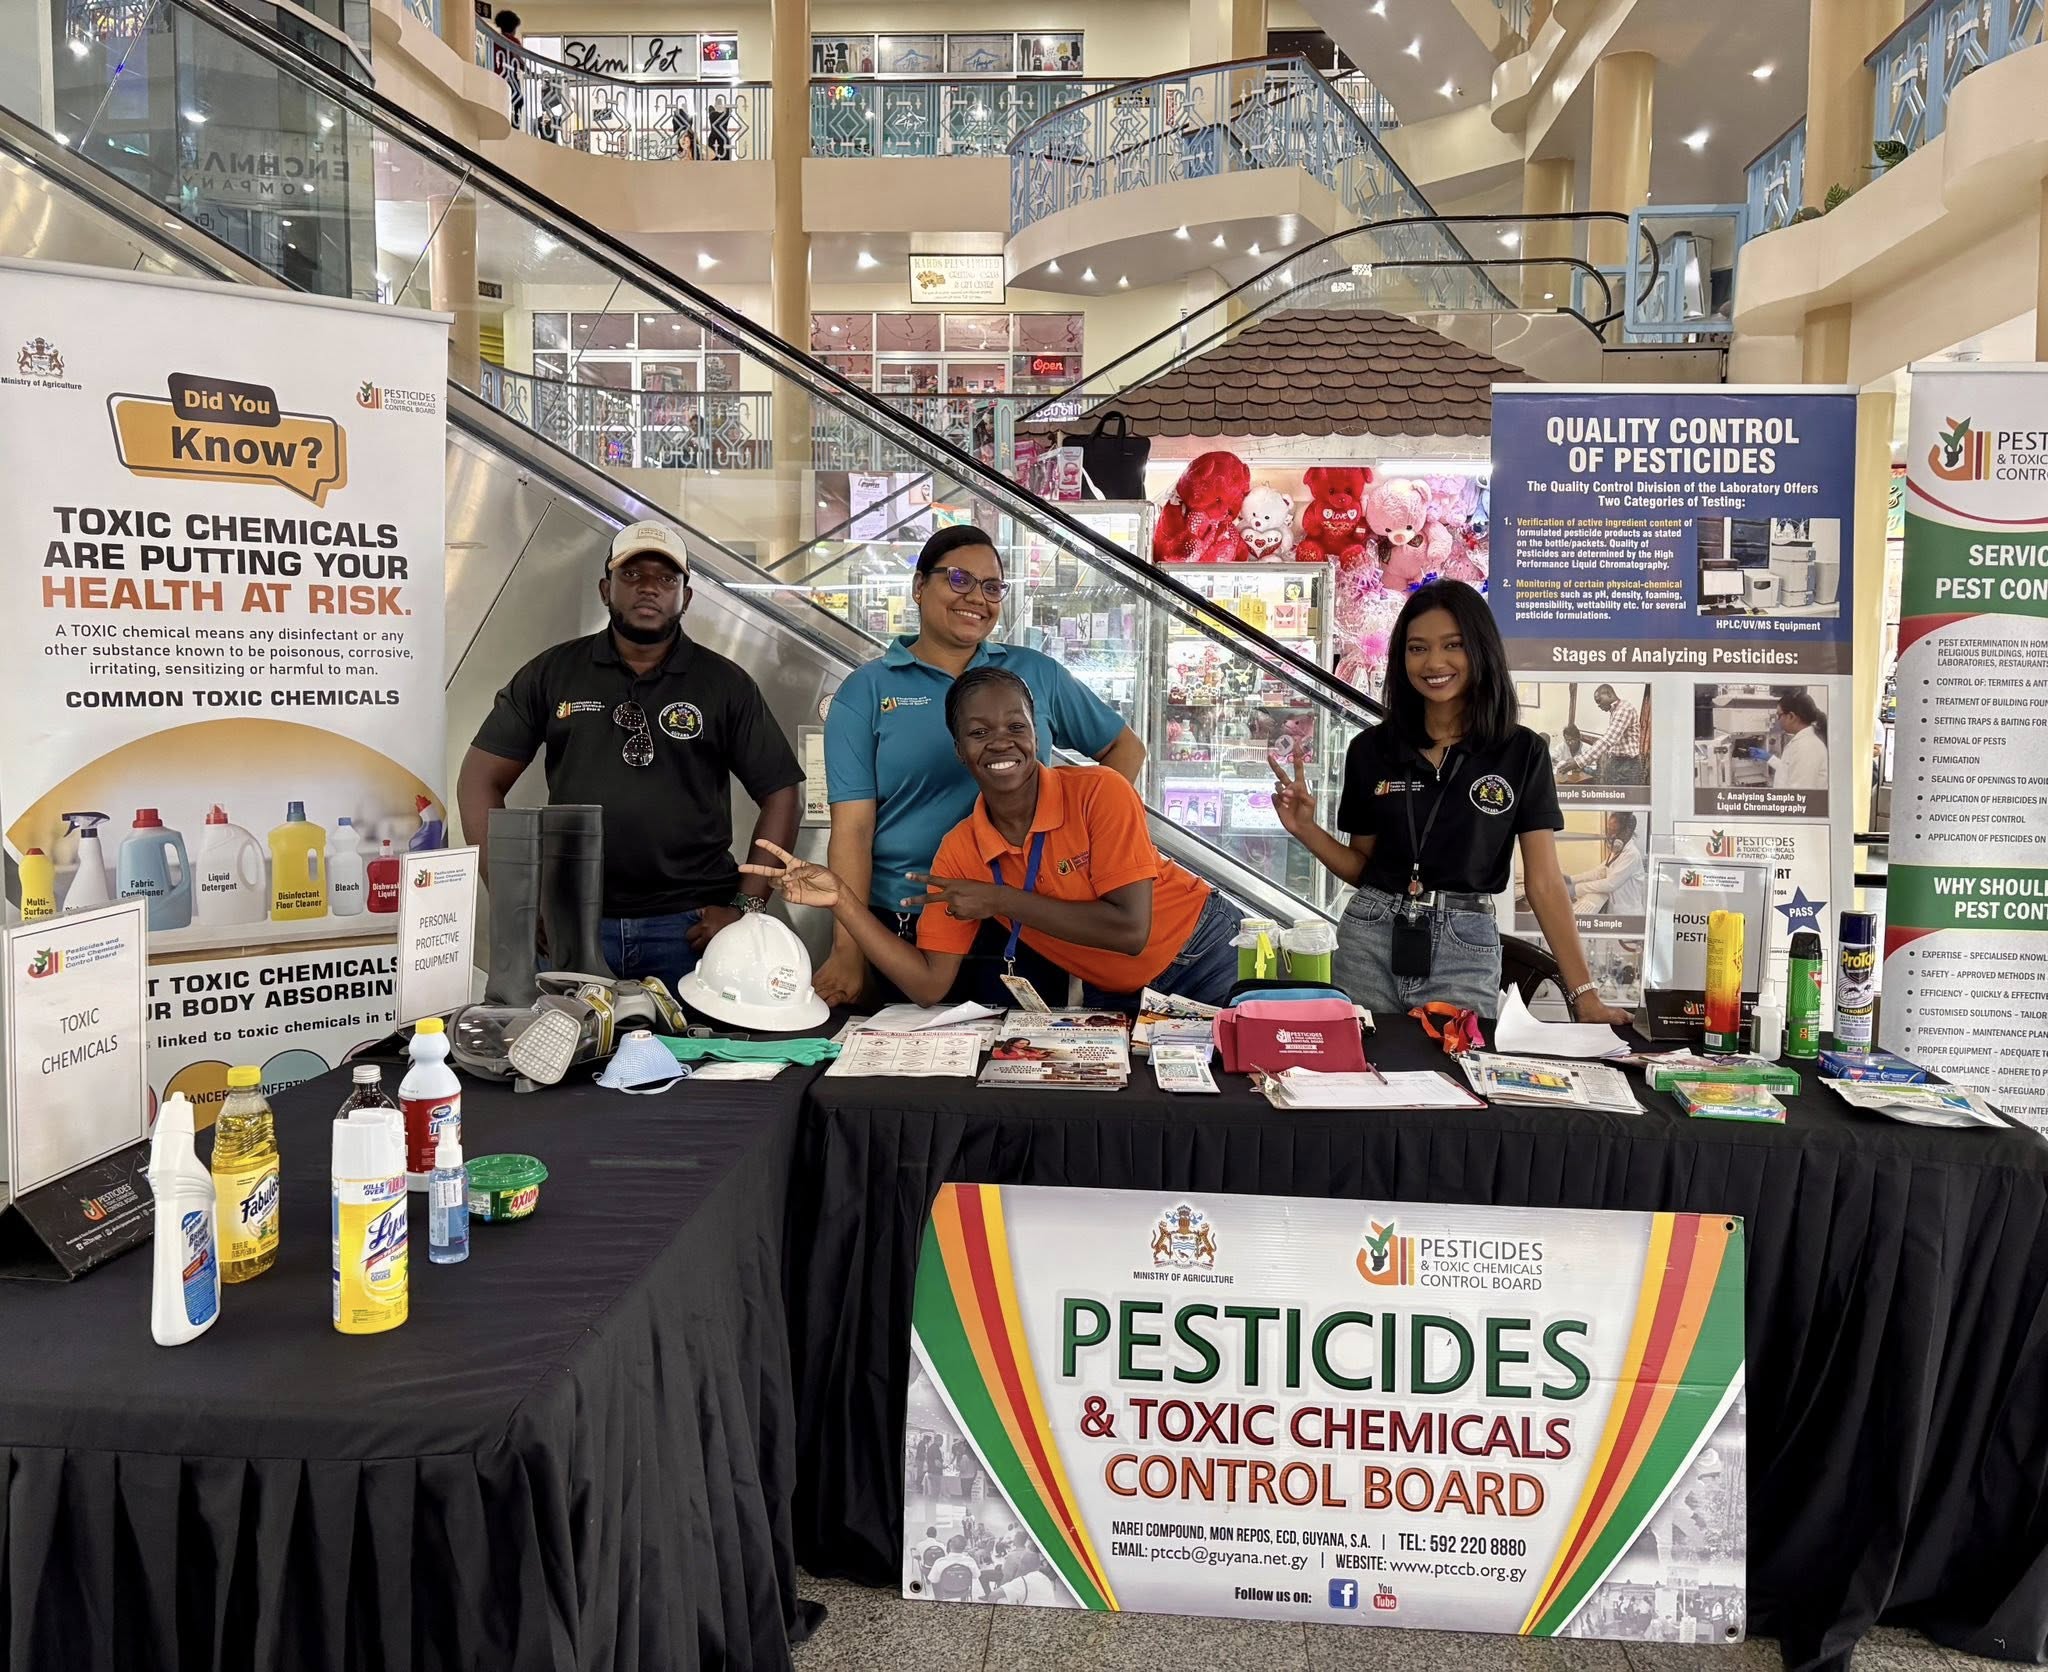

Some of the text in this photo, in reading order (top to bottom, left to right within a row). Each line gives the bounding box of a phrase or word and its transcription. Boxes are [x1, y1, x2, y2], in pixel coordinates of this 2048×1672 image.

[1032, 358, 1064, 374] Open
[1, 376, 31, 387] Ministry
[42, 379, 82, 390] Agriculture
[184, 389, 269, 414] Did You
[383, 388, 436, 402] PESTICIDES
[1546, 416, 1799, 446] QUALITY CONTROL
[171, 425, 322, 468] Know?
[1569, 446, 1775, 474] OF PESTICIDES
[1996, 453, 2006, 464] &
[1526, 480, 1818, 495] The Quality Control Division of the Laboratory Offers
[1597, 495, 1745, 509] Two Categories of Testing:
[53, 506, 398, 548] TOXIC CHEMICALS
[1503, 516, 1692, 528] 1. Verification of active ingredient content of
[43, 540, 408, 579] ARE PUTTING YOUR
[42, 575, 411, 615] HEALTH AT RISK.
[1935, 577, 2048, 600] PEST CON
[55, 624, 404, 644] A TOXIC chemical means any disinfectant or any
[1716, 619, 1820, 632] HPLC/UV/MS Equipment
[1552, 646, 1798, 666] Stages of Analyzing Pesticides:
[66, 689, 399, 707] COMMON TOXIC CHEMICALS
[1933, 736, 2006, 745] REMOVAL OF PESTS
[1931, 755, 1980, 764] FUMIGATION
[1581, 789, 1625, 798] Submission
[1716, 791, 1806, 803] 4. Analysing Sample by
[1716, 801, 1806, 813] Liquid Chromatography
[130, 878, 154, 888] Fabric
[208, 872, 229, 882] Liquid
[1933, 877, 1976, 894] WHY
[201, 882, 237, 892] Detergent
[278, 889, 319, 900] Disinfectant
[334, 882, 359, 891] Bleach
[23, 906, 53, 915] Surface
[275, 899, 322, 909] Floor Cleaner
[1789, 906, 1813, 917] PASS
[1954, 901, 2000, 918] PEST
[419, 911, 457, 928] PERSONAL
[1593, 918, 1622, 929] Sample
[415, 930, 459, 950] PROTECTIVE
[414, 950, 459, 971] EQUIPMENT
[169, 970, 249, 994] TOXIC
[182, 981, 396, 1017] BODY ABSORBIN
[59, 1007, 99, 1034] TOXIC
[41, 1035, 117, 1074] CHEMICALS
[1421, 1238, 1542, 1261] PESTICIDES
[1420, 1259, 1542, 1275] & TOXIC CHEMICALS
[1133, 1271, 1234, 1284] MINISTRY OF AGRICULTURE
[1420, 1274, 1541, 1290] CONTROL BOARD
[1062, 1297, 1590, 1400] PESTICIDES
[1080, 1395, 1571, 1460] & TOXIC CHEMICALS
[1104, 1453, 1544, 1517] CONTROL BOARD
[1112, 1520, 1370, 1548] NAREI COMPOUND, MON REPOS, ECD, GUYANA, S.A.
[1398, 1532, 1526, 1556] TEL: 592 220 8880
[1111, 1541, 1308, 1570] EMAIL: ptccb@guyana.net.gy
[1335, 1553, 1527, 1582] WEBSITE: www.ptccb.org.gy
[1234, 1586, 1311, 1603] Follow us on:
[1378, 1582, 1393, 1594] You
[1376, 1595, 1395, 1608] Tube
